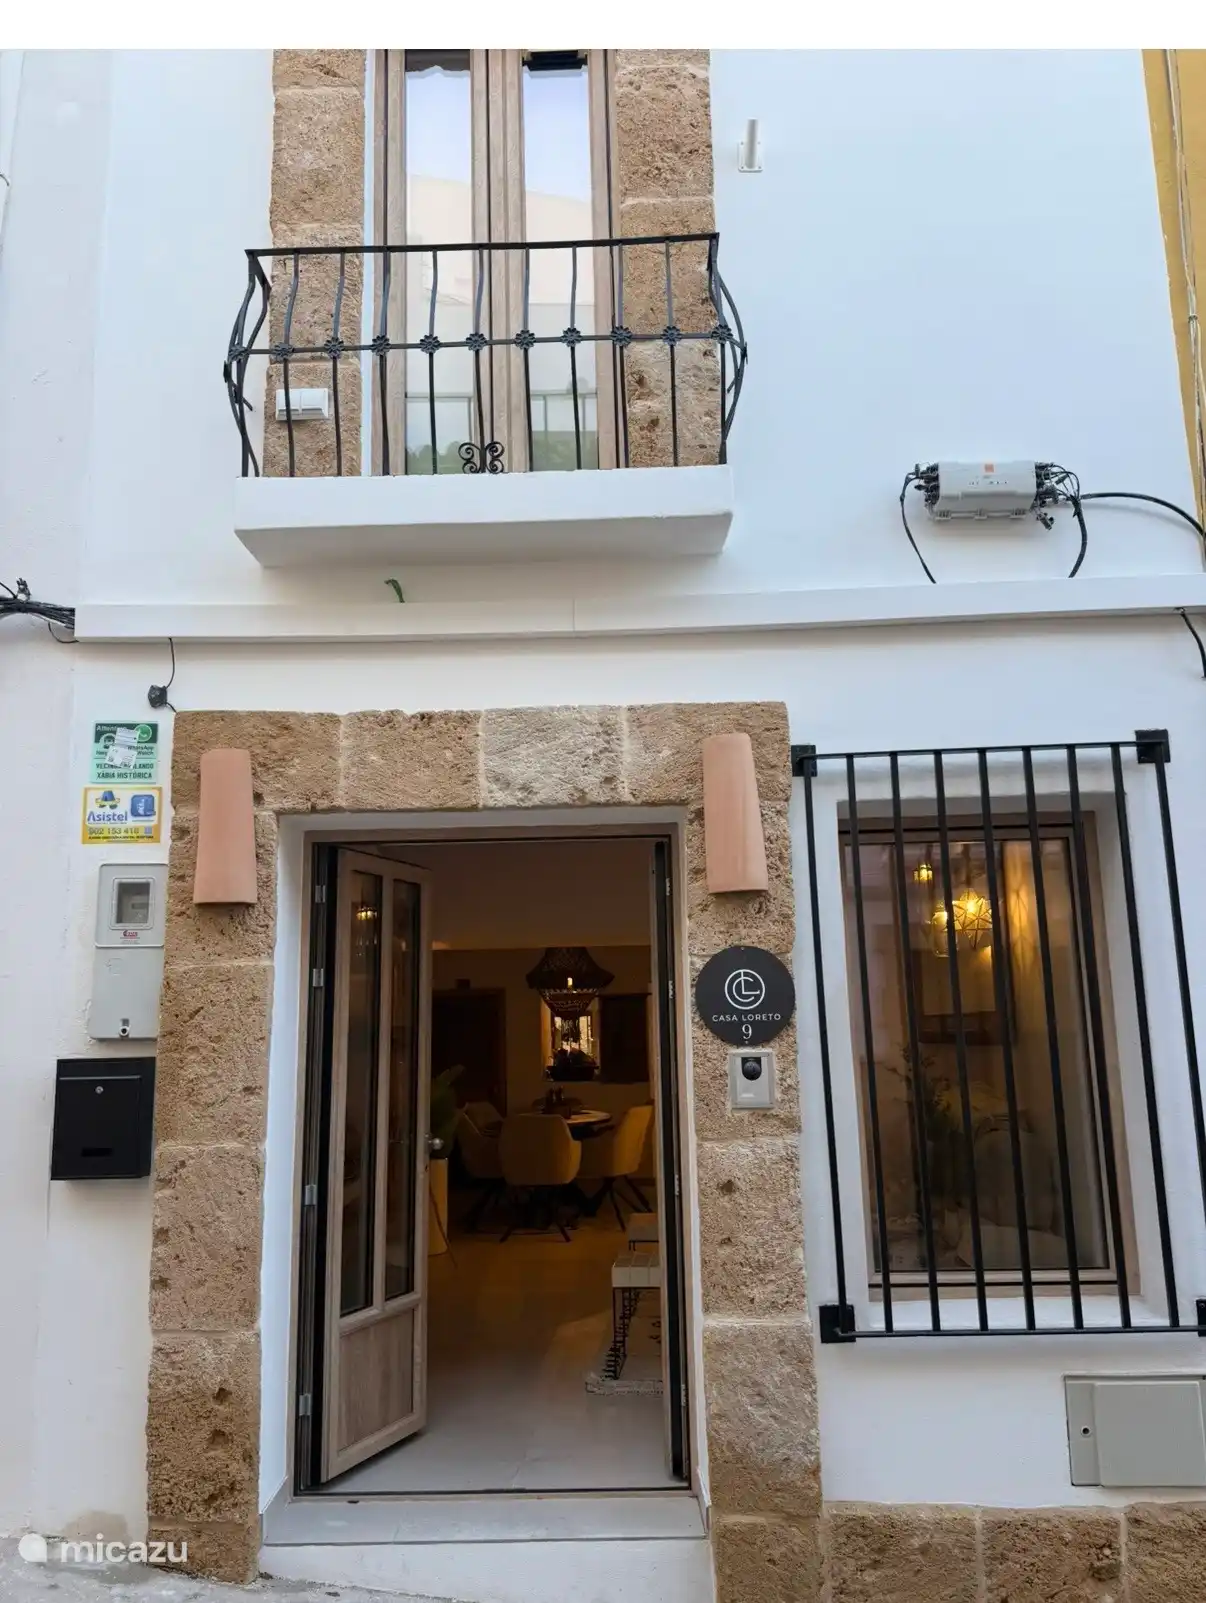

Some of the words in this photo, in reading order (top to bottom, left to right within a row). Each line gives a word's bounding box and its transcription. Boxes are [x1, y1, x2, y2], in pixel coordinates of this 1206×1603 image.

[87, 810, 128, 822] Asistel
[712, 1014, 738, 1022] CASA
[742, 1013, 781, 1021] LORETO
[742, 1023, 752, 1040] 9
